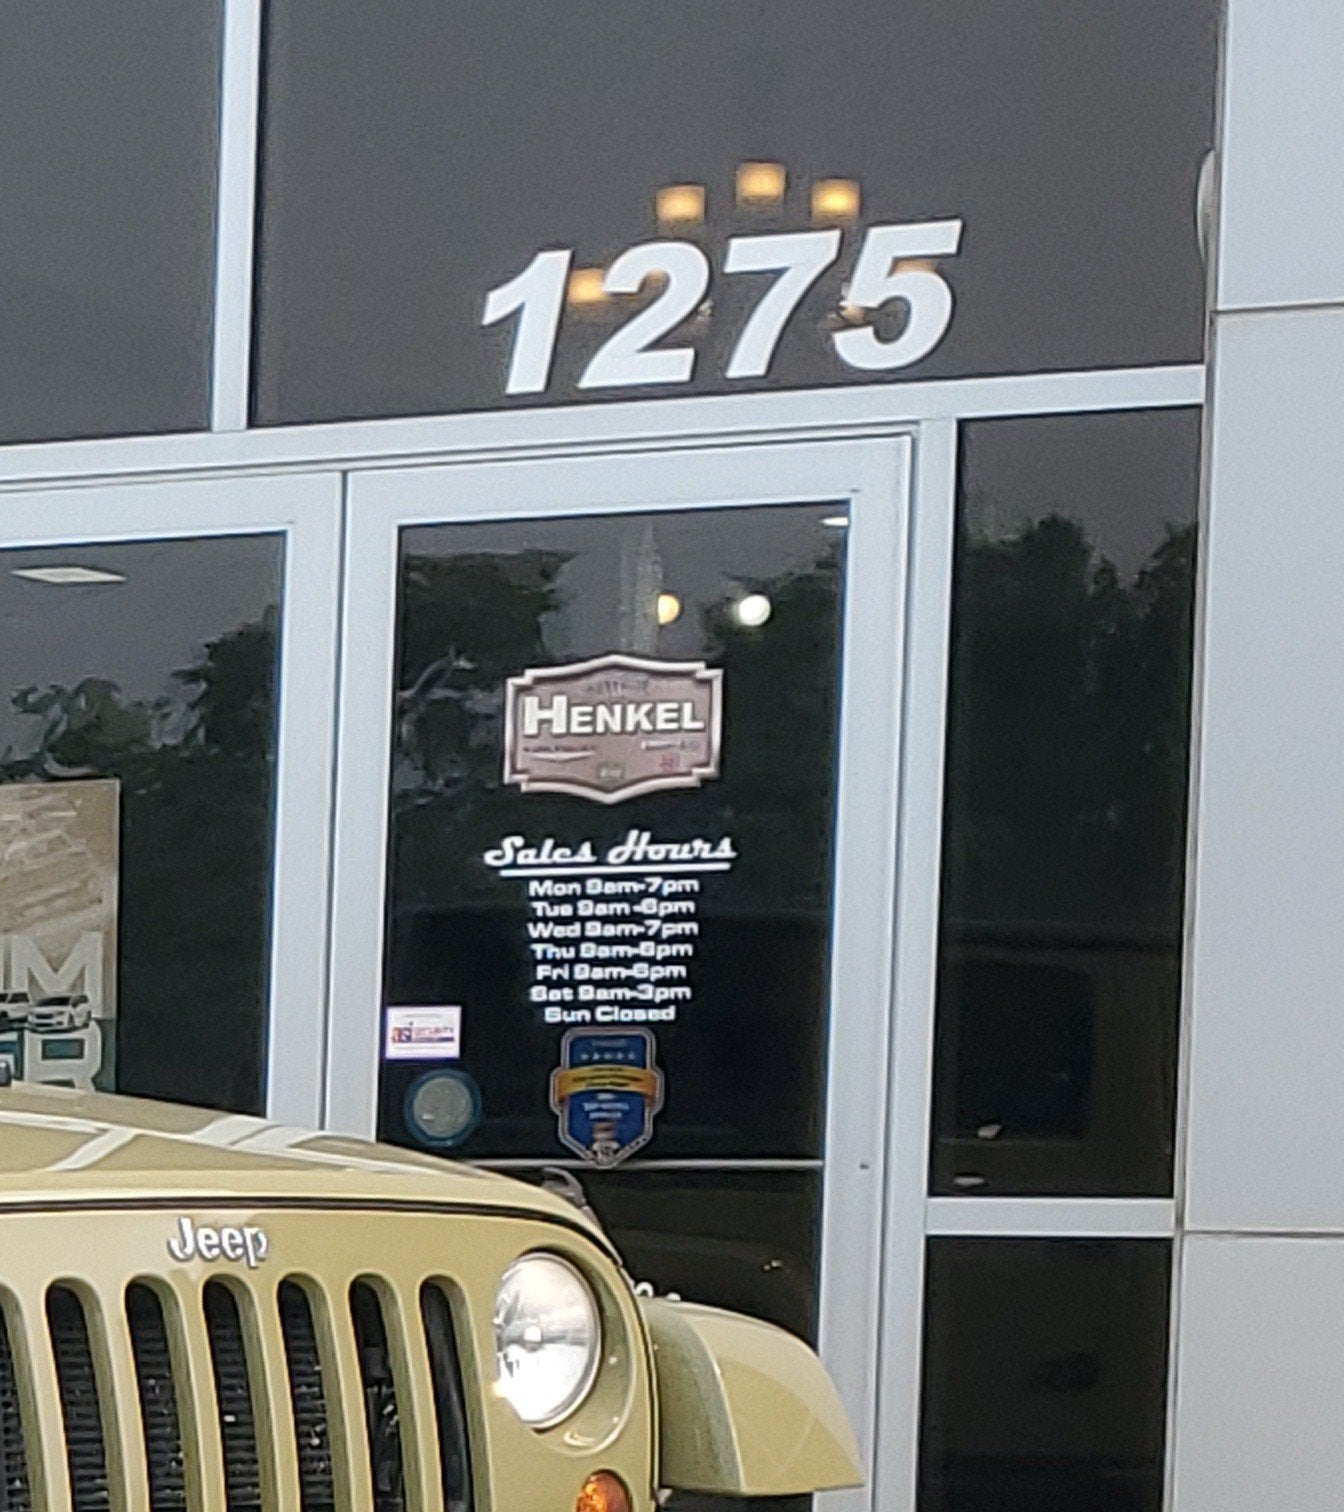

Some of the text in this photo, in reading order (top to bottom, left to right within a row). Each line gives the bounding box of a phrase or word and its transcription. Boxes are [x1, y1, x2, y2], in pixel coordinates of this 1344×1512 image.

[481, 219, 963, 395] 1275
[522, 695, 705, 736] HENKEL
[483, 829, 737, 866] Sales Hours
[529, 879, 581, 896] Mon
[531, 901, 573, 917] Tue
[527, 921, 581, 938] Wed
[530, 943, 575, 960] Thu
[536, 964, 569, 980] Fri
[529, 985, 573, 1001] Sat
[544, 1005, 676, 1023] Sun Closed
[169, 1216, 268, 1269] Jeep
